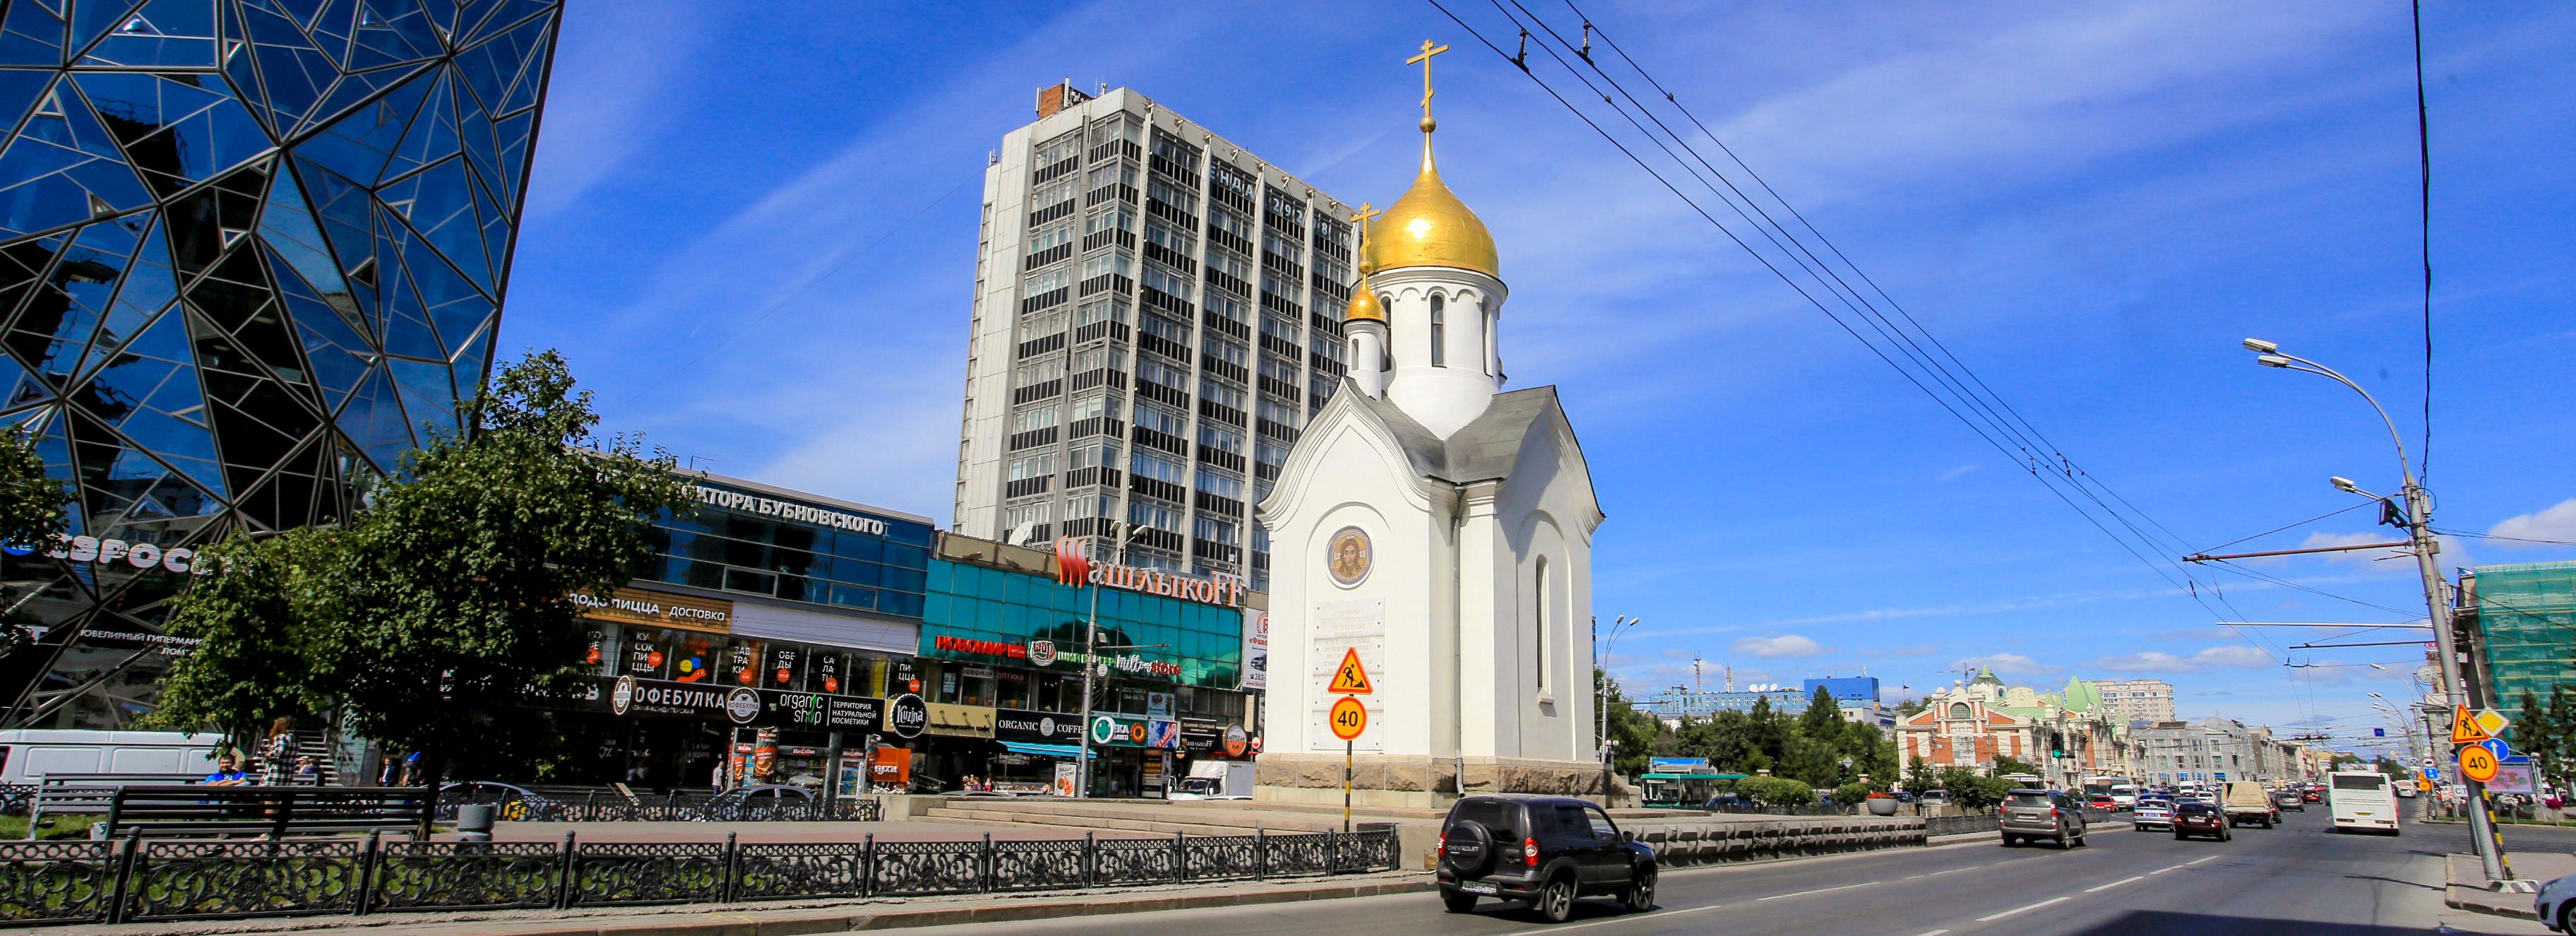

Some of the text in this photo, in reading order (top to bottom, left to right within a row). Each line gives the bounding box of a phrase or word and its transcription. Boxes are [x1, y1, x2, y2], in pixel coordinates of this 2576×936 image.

[759, 498, 884, 535] БУБНОВСКОГО
[612, 598, 660, 615] ПИЦЦА
[80, 629, 145, 641] ЮВЕЛИРНЫЙ
[634, 643, 655, 651] СОК
[936, 635, 1008, 656] НОВОМИР
[632, 663, 655, 673] ЦЦЫ
[777, 660, 792, 670] ДЫ
[636, 686, 724, 709] ОФЕБУЛКА
[780, 693, 823, 709] organic
[729, 701, 759, 710] КОФЕБУЛКА
[833, 701, 871, 711] ТЕРРИТОРИЯ
[794, 707, 822, 725] shop
[832, 711, 877, 719] НАТУРАЛЬНОЙ
[896, 704, 924, 724] Kuzina
[1337, 711, 1359, 727] 40
[831, 717, 869, 725] КОСМЕТИКИ
[998, 719, 1038, 730] ORGANIC
[1056, 723, 1083, 733] COFFE
[2468, 757, 2488, 770] 40
